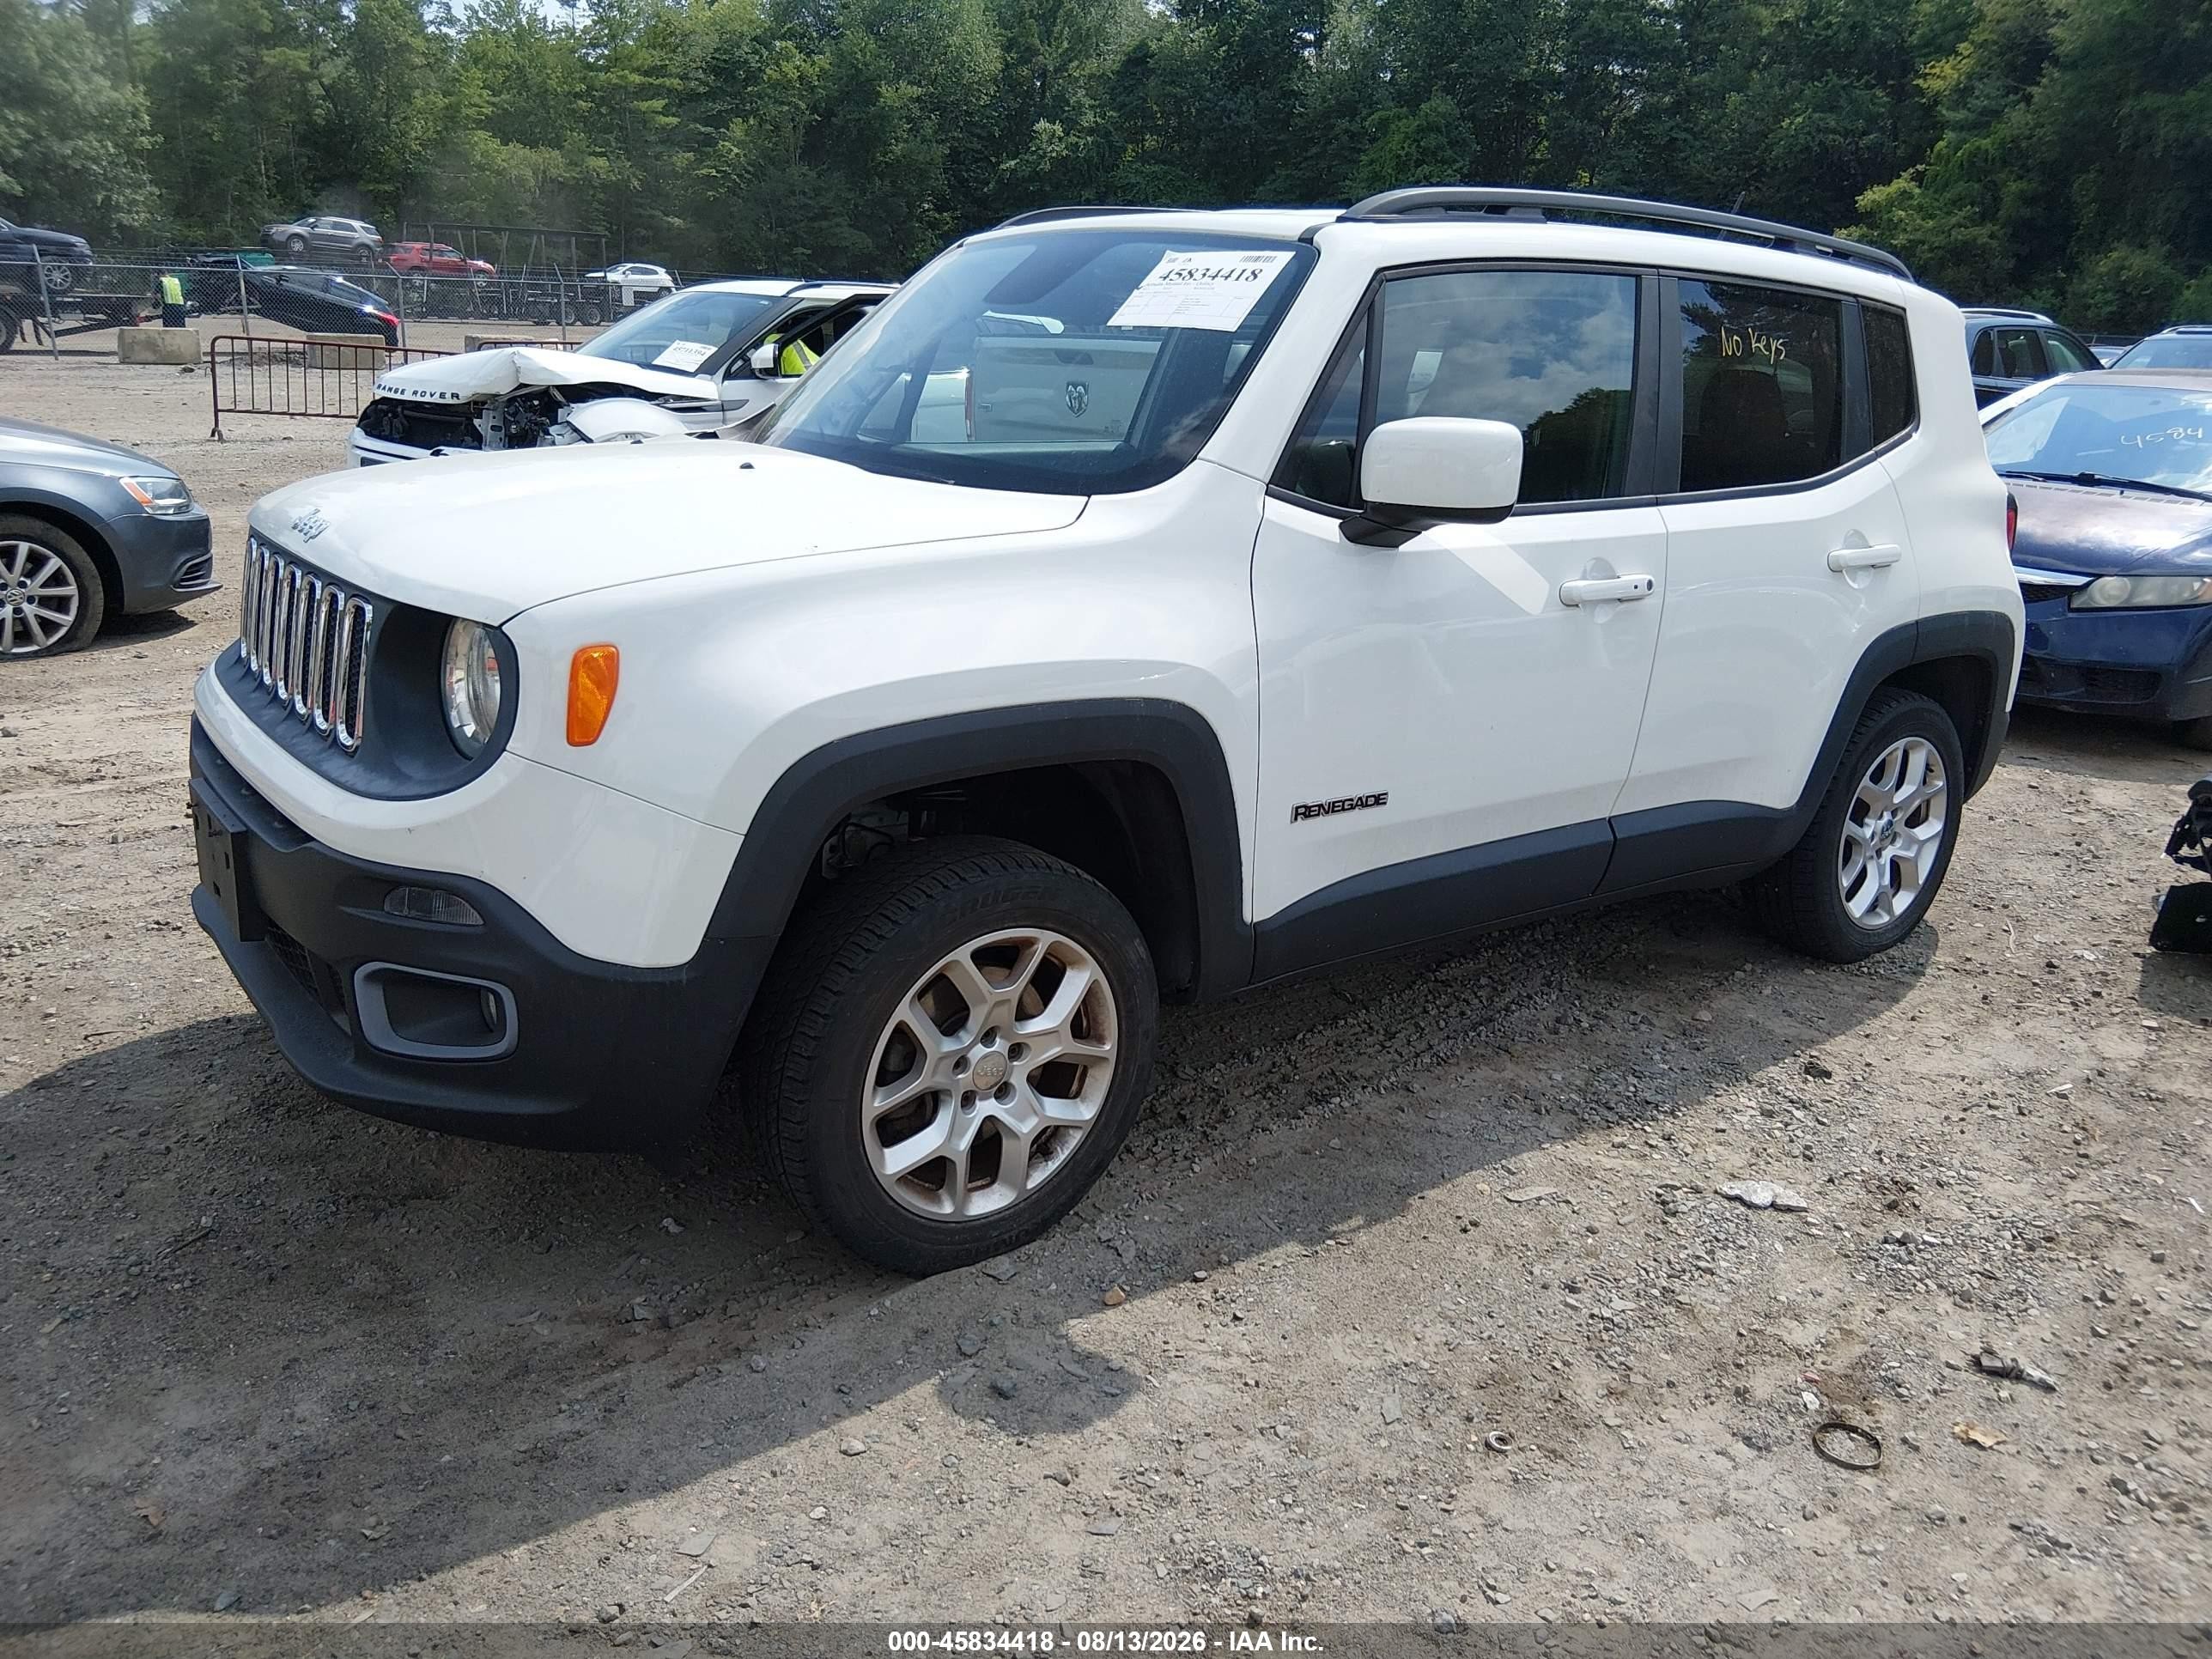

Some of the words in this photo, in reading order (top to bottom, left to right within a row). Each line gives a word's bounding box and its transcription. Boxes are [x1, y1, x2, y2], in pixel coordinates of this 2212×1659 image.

[1159, 267, 1262, 282] 45834418
[376, 383, 406, 396] RANGE
[411, 390, 461, 400] ROVER
[1291, 790, 1389, 824] RENEGADE
